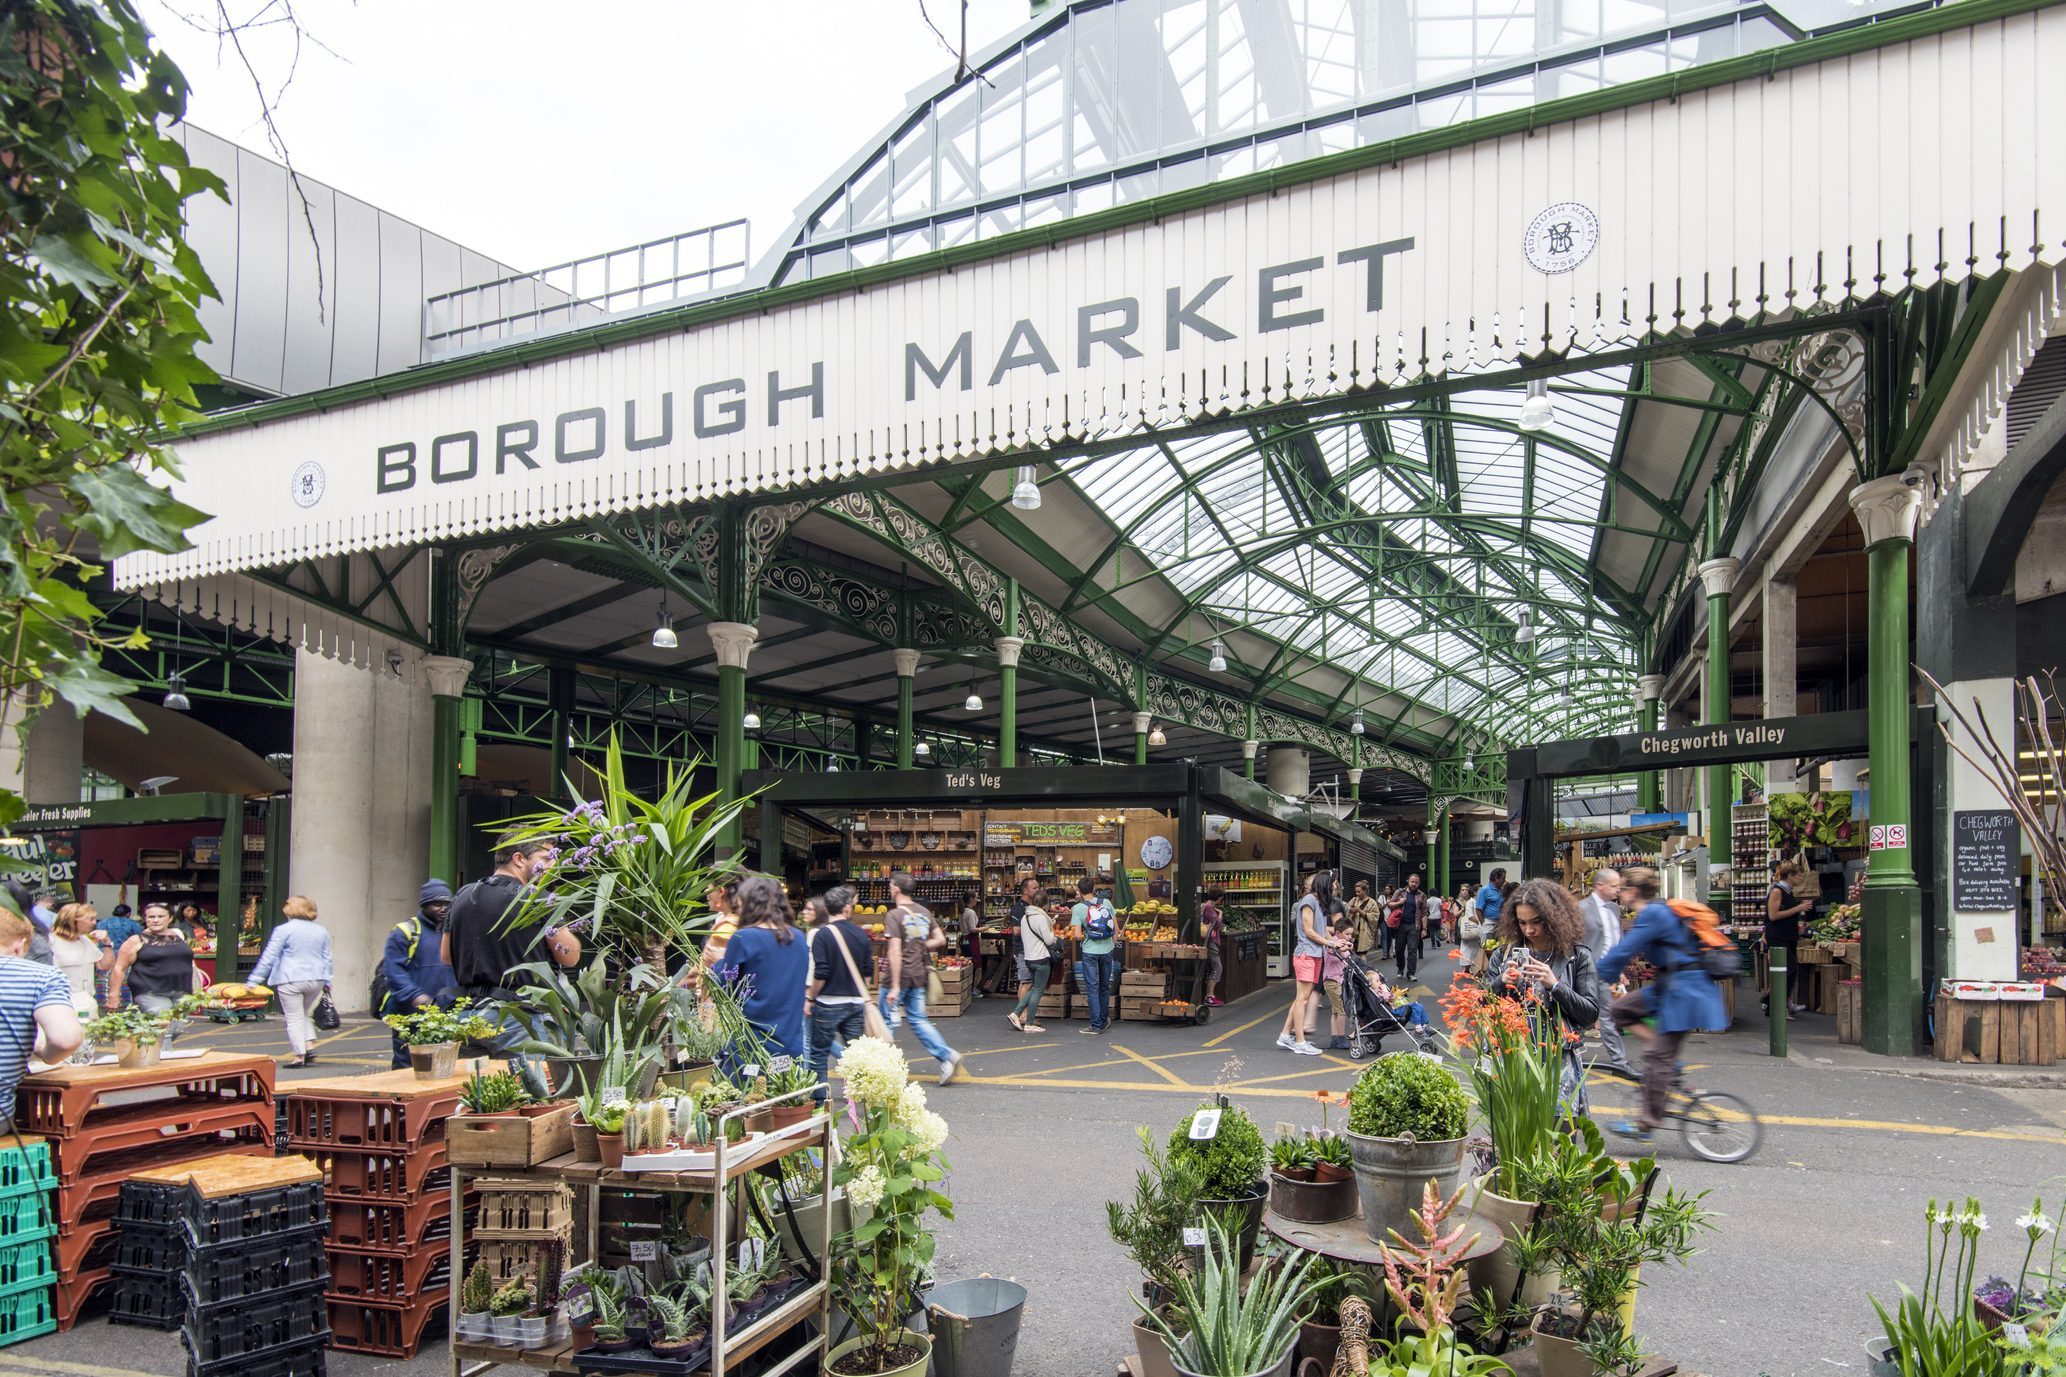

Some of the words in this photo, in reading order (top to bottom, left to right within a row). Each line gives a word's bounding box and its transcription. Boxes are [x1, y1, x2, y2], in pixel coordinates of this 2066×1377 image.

[1527, 206, 1566, 255] BOROUGH
[1570, 206, 1596, 244] MARKET
[376, 361, 824, 495] BOROUGH
[904, 236, 1415, 401] MARKET
[1641, 729, 1728, 754] Chegworth
[1735, 725, 1786, 744] Valley
[945, 773, 976, 788] Ted's
[980, 772, 1001, 789] Veg
[41, 807, 60, 821] Fresh
[62, 806, 92, 821] Supplies
[1059, 824, 1084, 837] VEG
[1960, 816, 2013, 829] CHEGWORTH
[1973, 830, 2002, 841] VALLEY
[0, 834, 46, 860] aul
